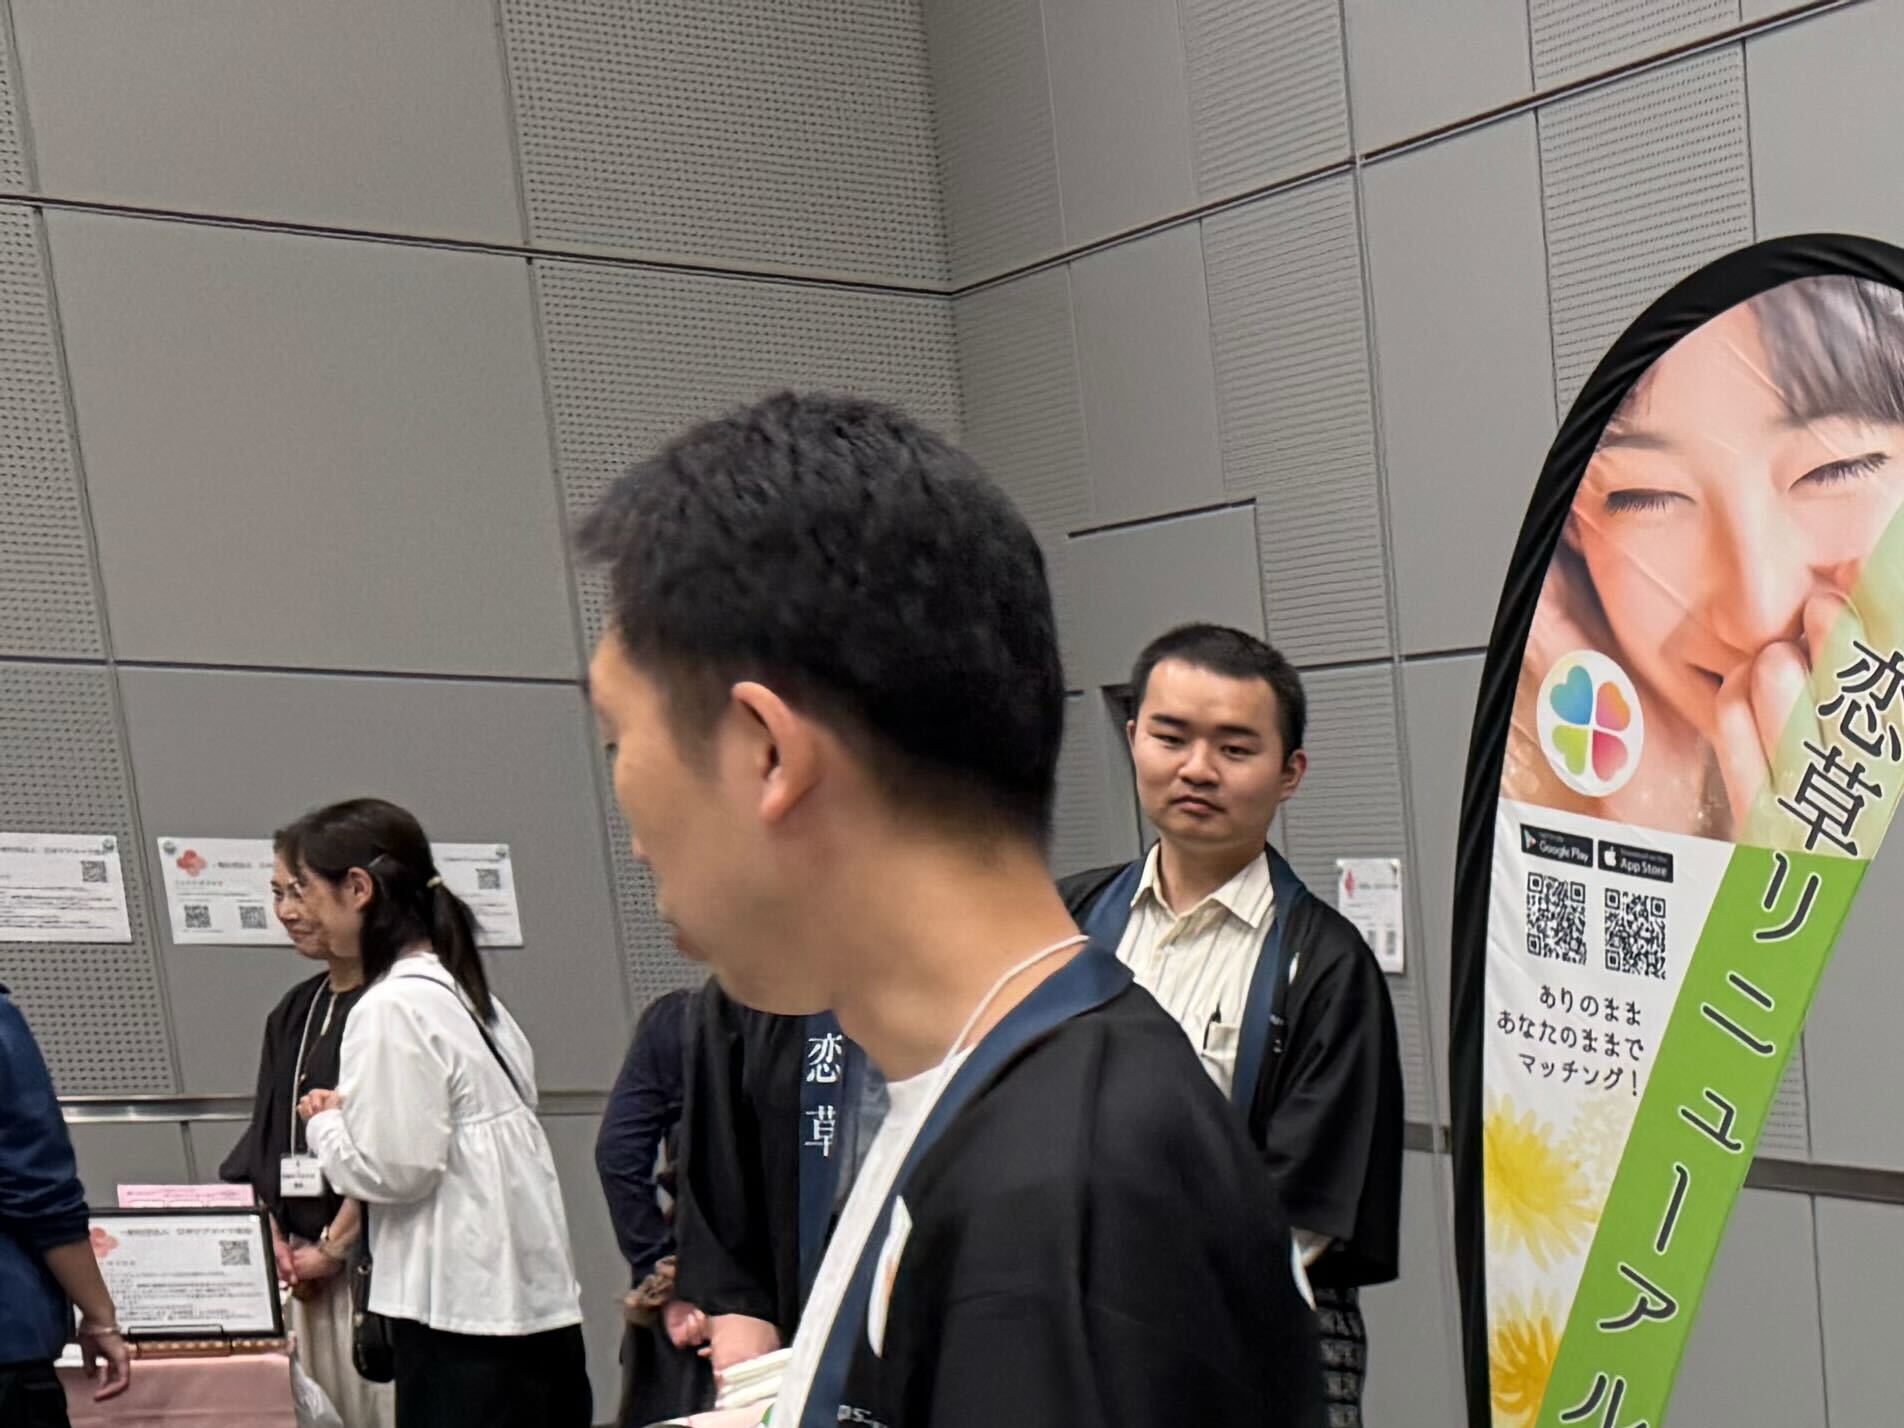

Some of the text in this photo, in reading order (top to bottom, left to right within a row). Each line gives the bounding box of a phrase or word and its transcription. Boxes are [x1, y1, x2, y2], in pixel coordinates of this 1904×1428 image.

[1539, 841, 1591, 866] Google Play
[1620, 855, 1667, 878] App Store
[1539, 983, 1642, 1027] ありのまま
[1496, 1009, 1645, 1062] あなたのままで
[1518, 1051, 1641, 1097] マッチング！
